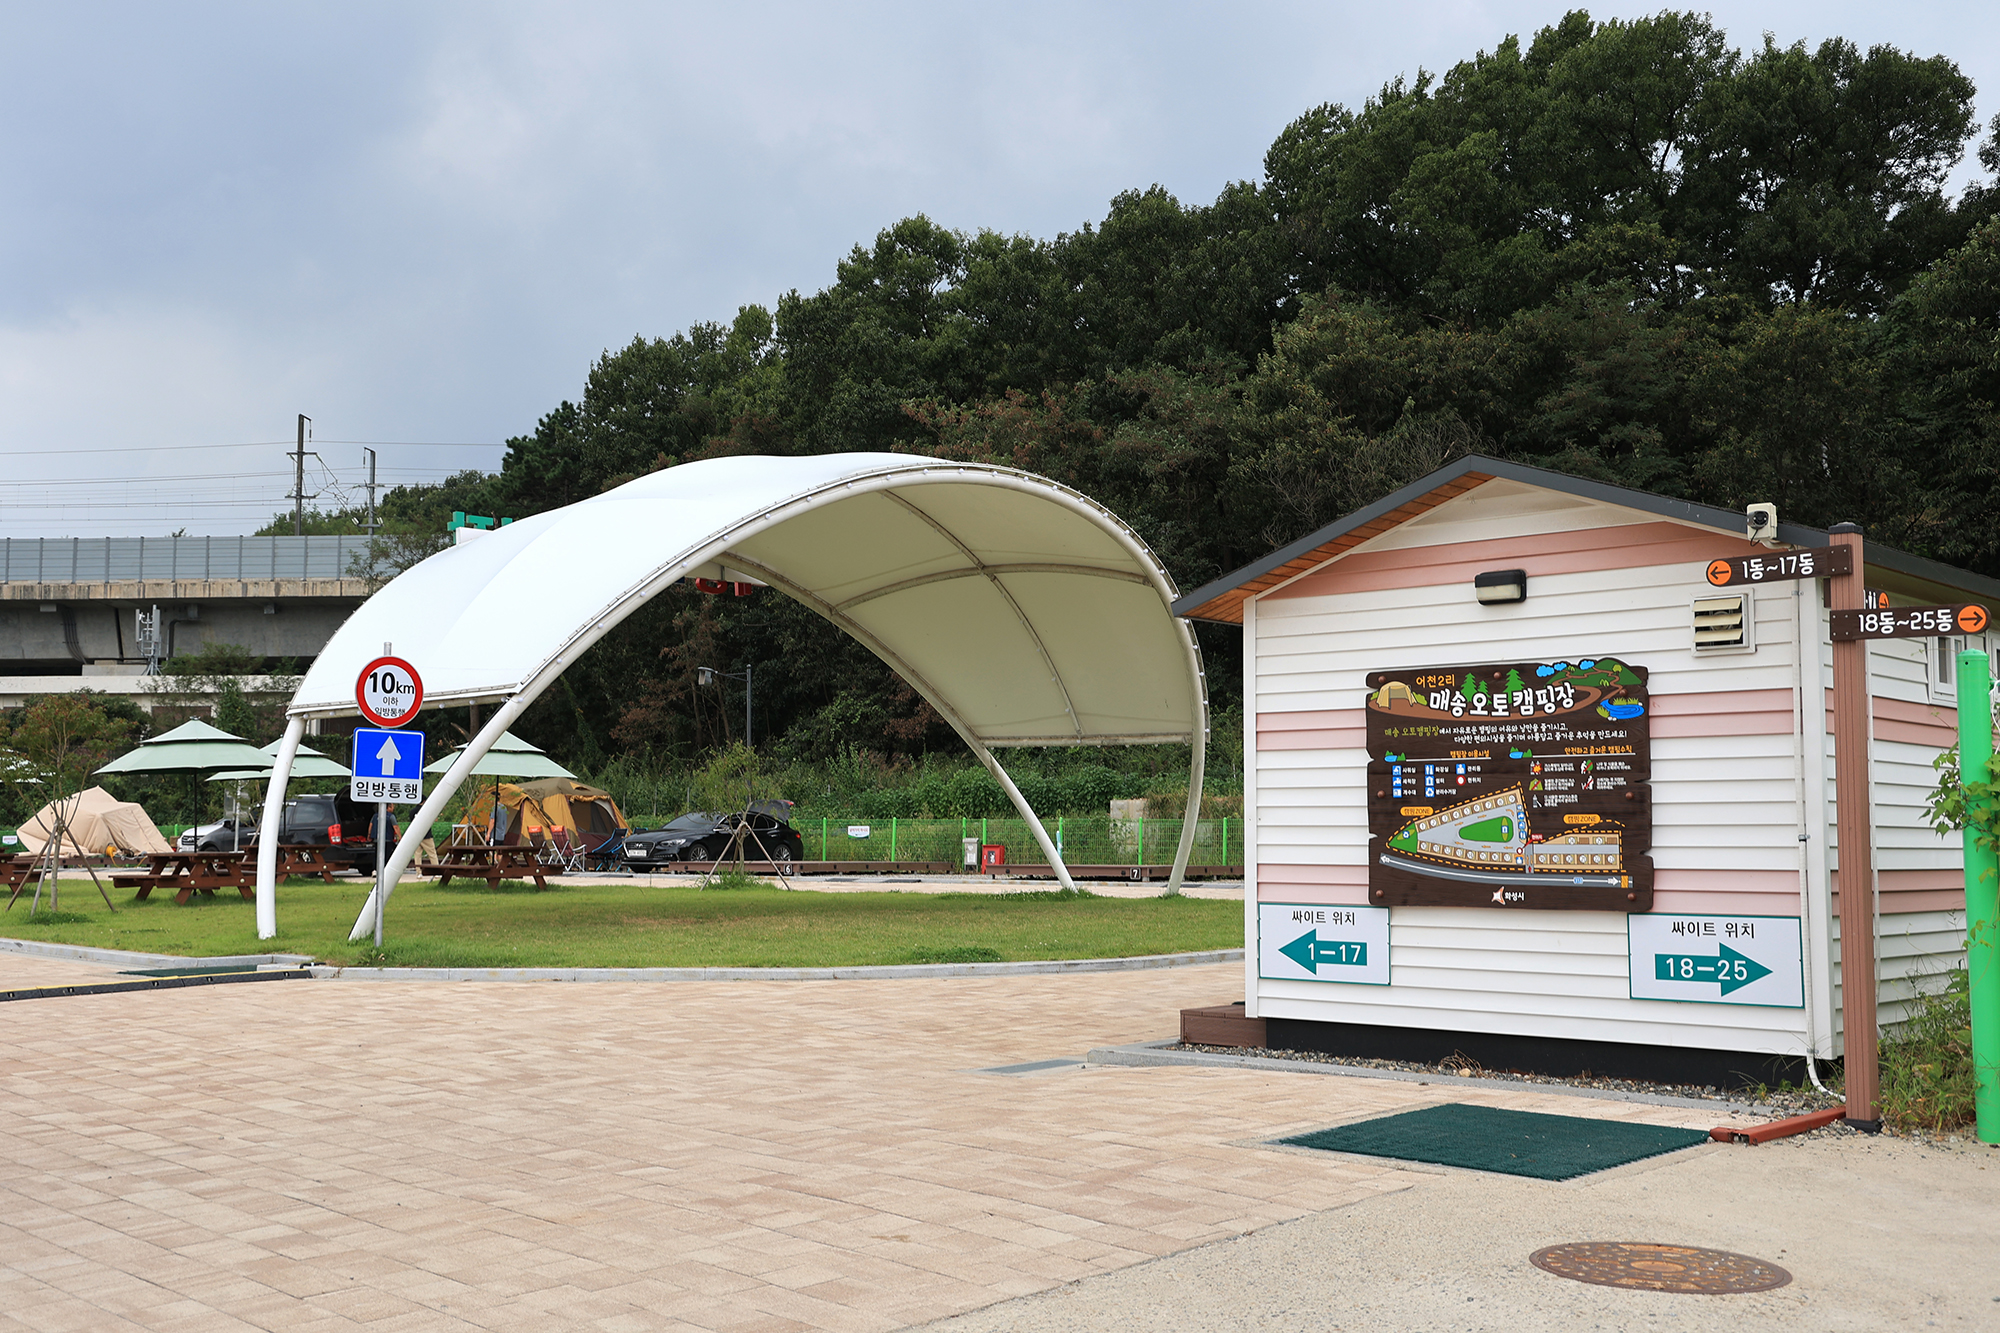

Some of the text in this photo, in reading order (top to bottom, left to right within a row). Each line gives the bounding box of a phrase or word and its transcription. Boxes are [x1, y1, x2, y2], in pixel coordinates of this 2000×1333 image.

[1742, 552, 1815, 581] 1동~17동
[1858, 608, 1953, 635] 18동~25동
[369, 672, 415, 695] 10km
[1415, 674, 1455, 689] 어천2리
[382, 696, 399, 706] 이하
[355, 781, 418, 800] 일방통행
[785, 864, 791, 874] 6
[1132, 869, 1138, 878] 7
[1504, 891, 1525, 902] 화성시
[1291, 909, 1356, 926] 싸이트 위치
[1670, 920, 1756, 940] 싸이트 위치
